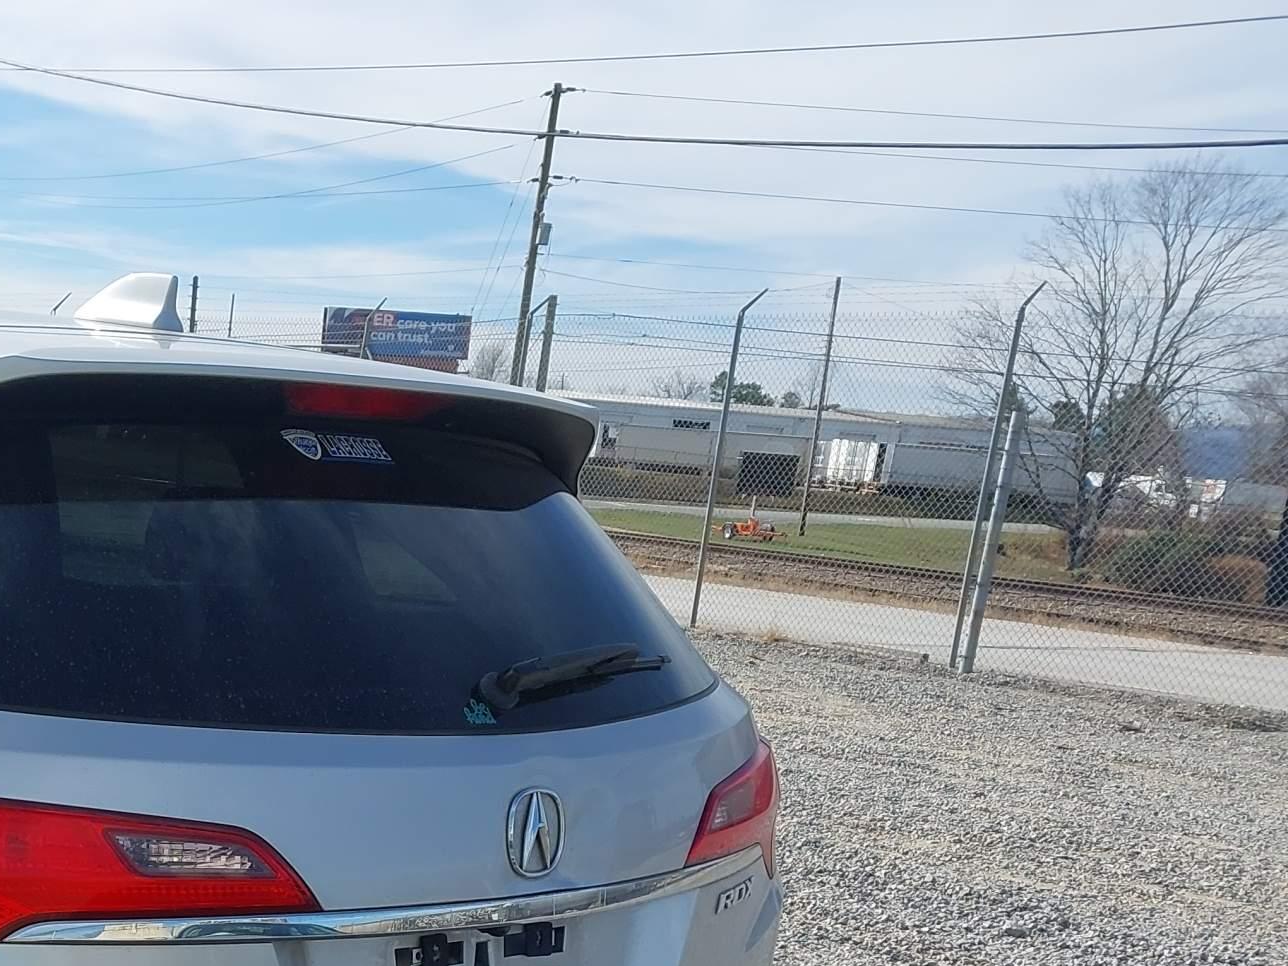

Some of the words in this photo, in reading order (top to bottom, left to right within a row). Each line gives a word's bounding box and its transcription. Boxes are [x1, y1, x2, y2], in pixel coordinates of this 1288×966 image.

[371, 330, 395, 341] can
[373, 313, 395, 327] ER
[396, 319, 426, 330] care
[429, 322, 457, 334] you
[316, 434, 393, 461] LACROSSE
[714, 875, 755, 915] RDX
